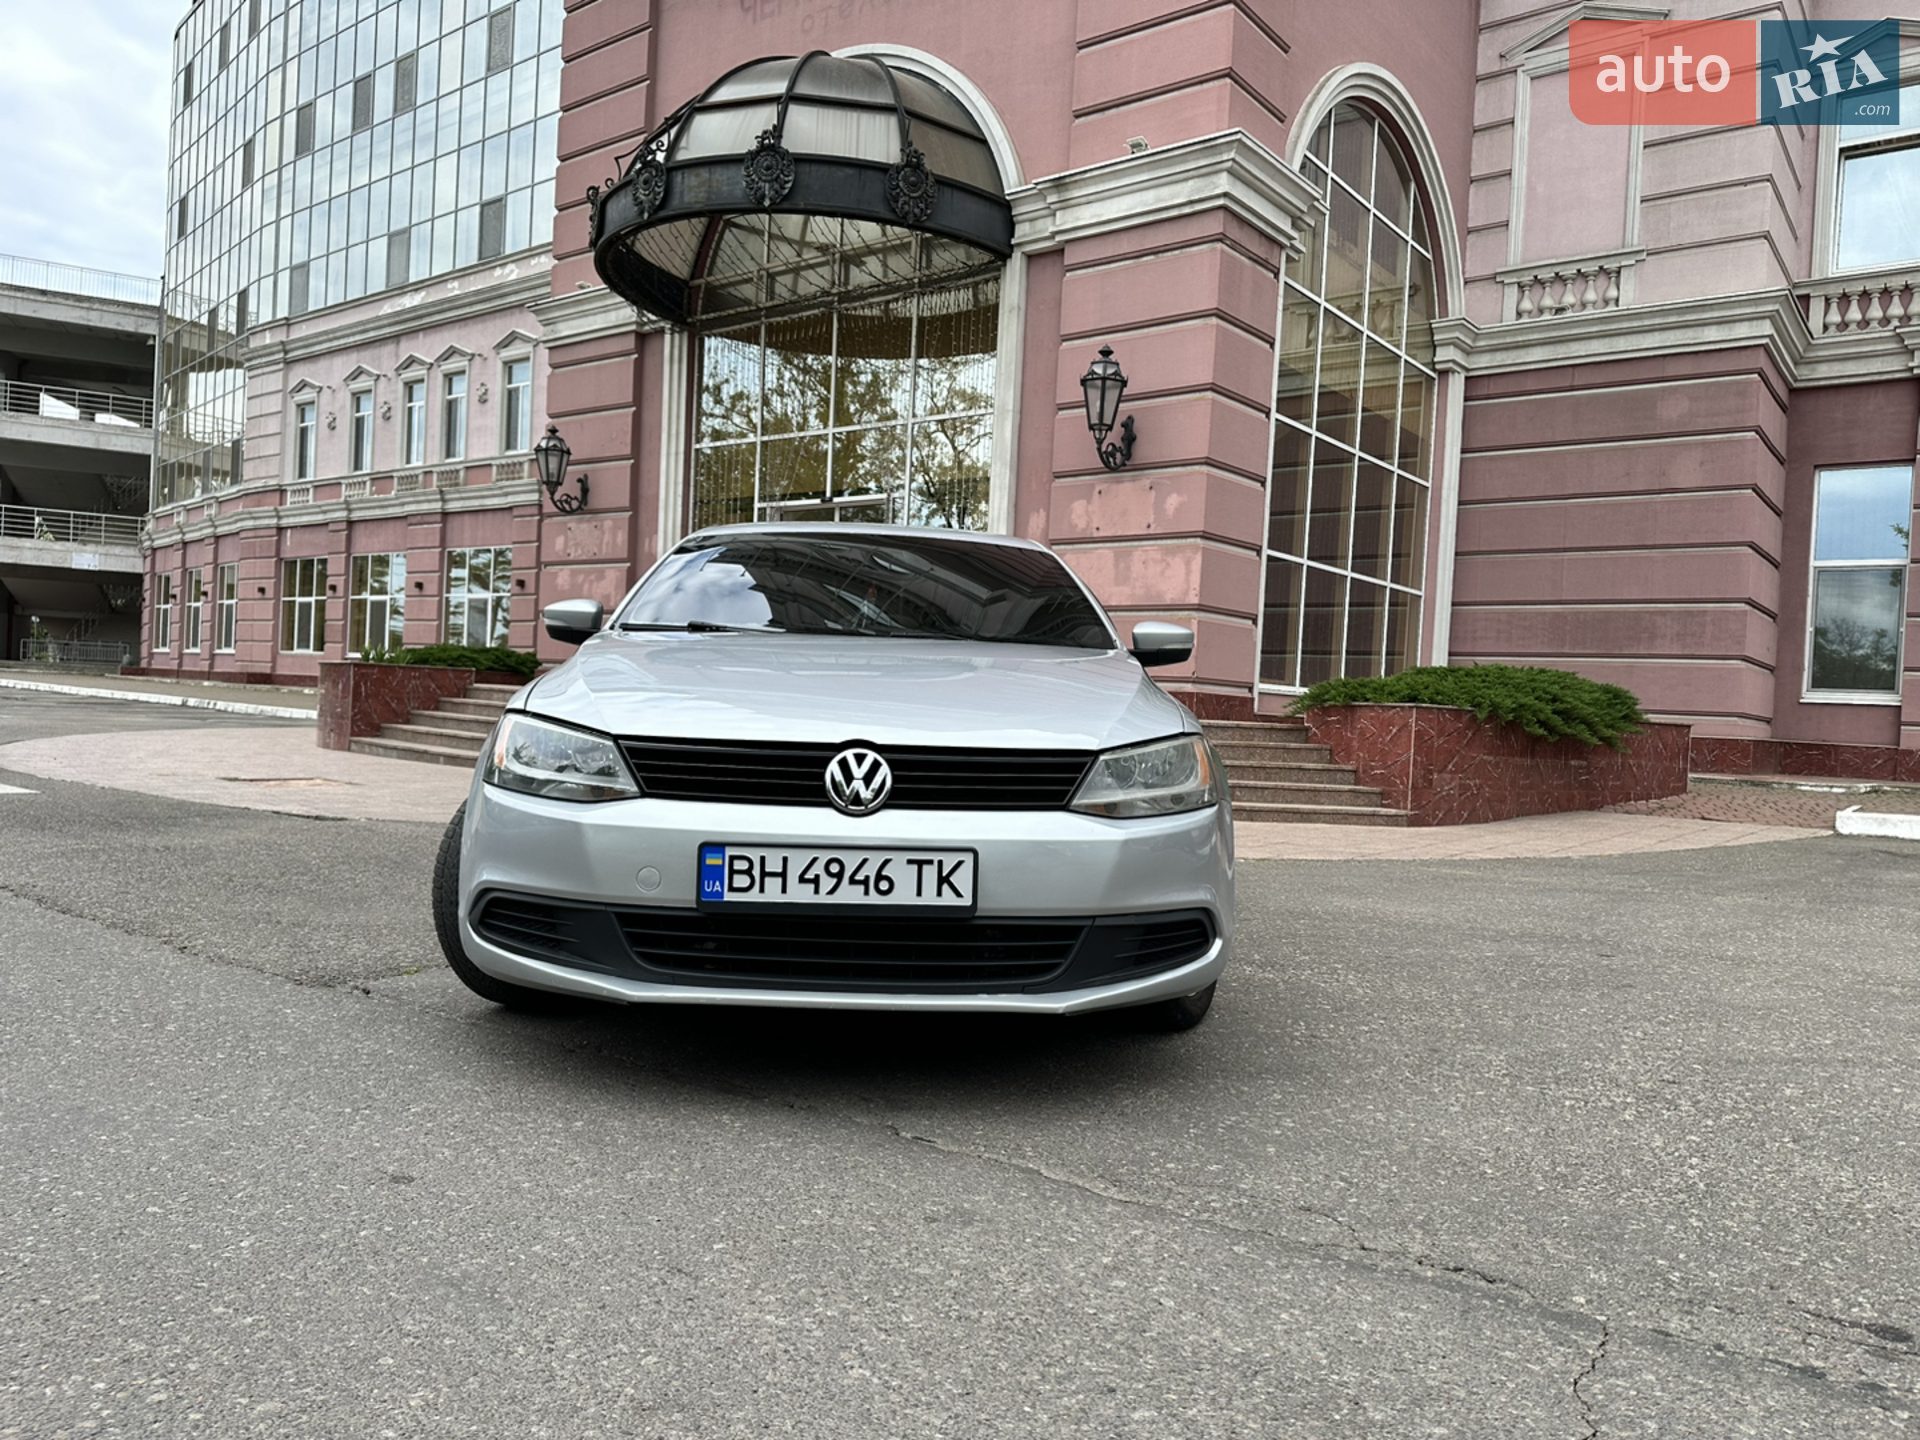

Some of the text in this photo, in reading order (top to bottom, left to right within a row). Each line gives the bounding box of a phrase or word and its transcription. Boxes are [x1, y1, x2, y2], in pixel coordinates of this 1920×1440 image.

[828, 750, 889, 808] VW
[704, 879, 722, 893] UA
[726, 854, 966, 898] BH 4946 TK
